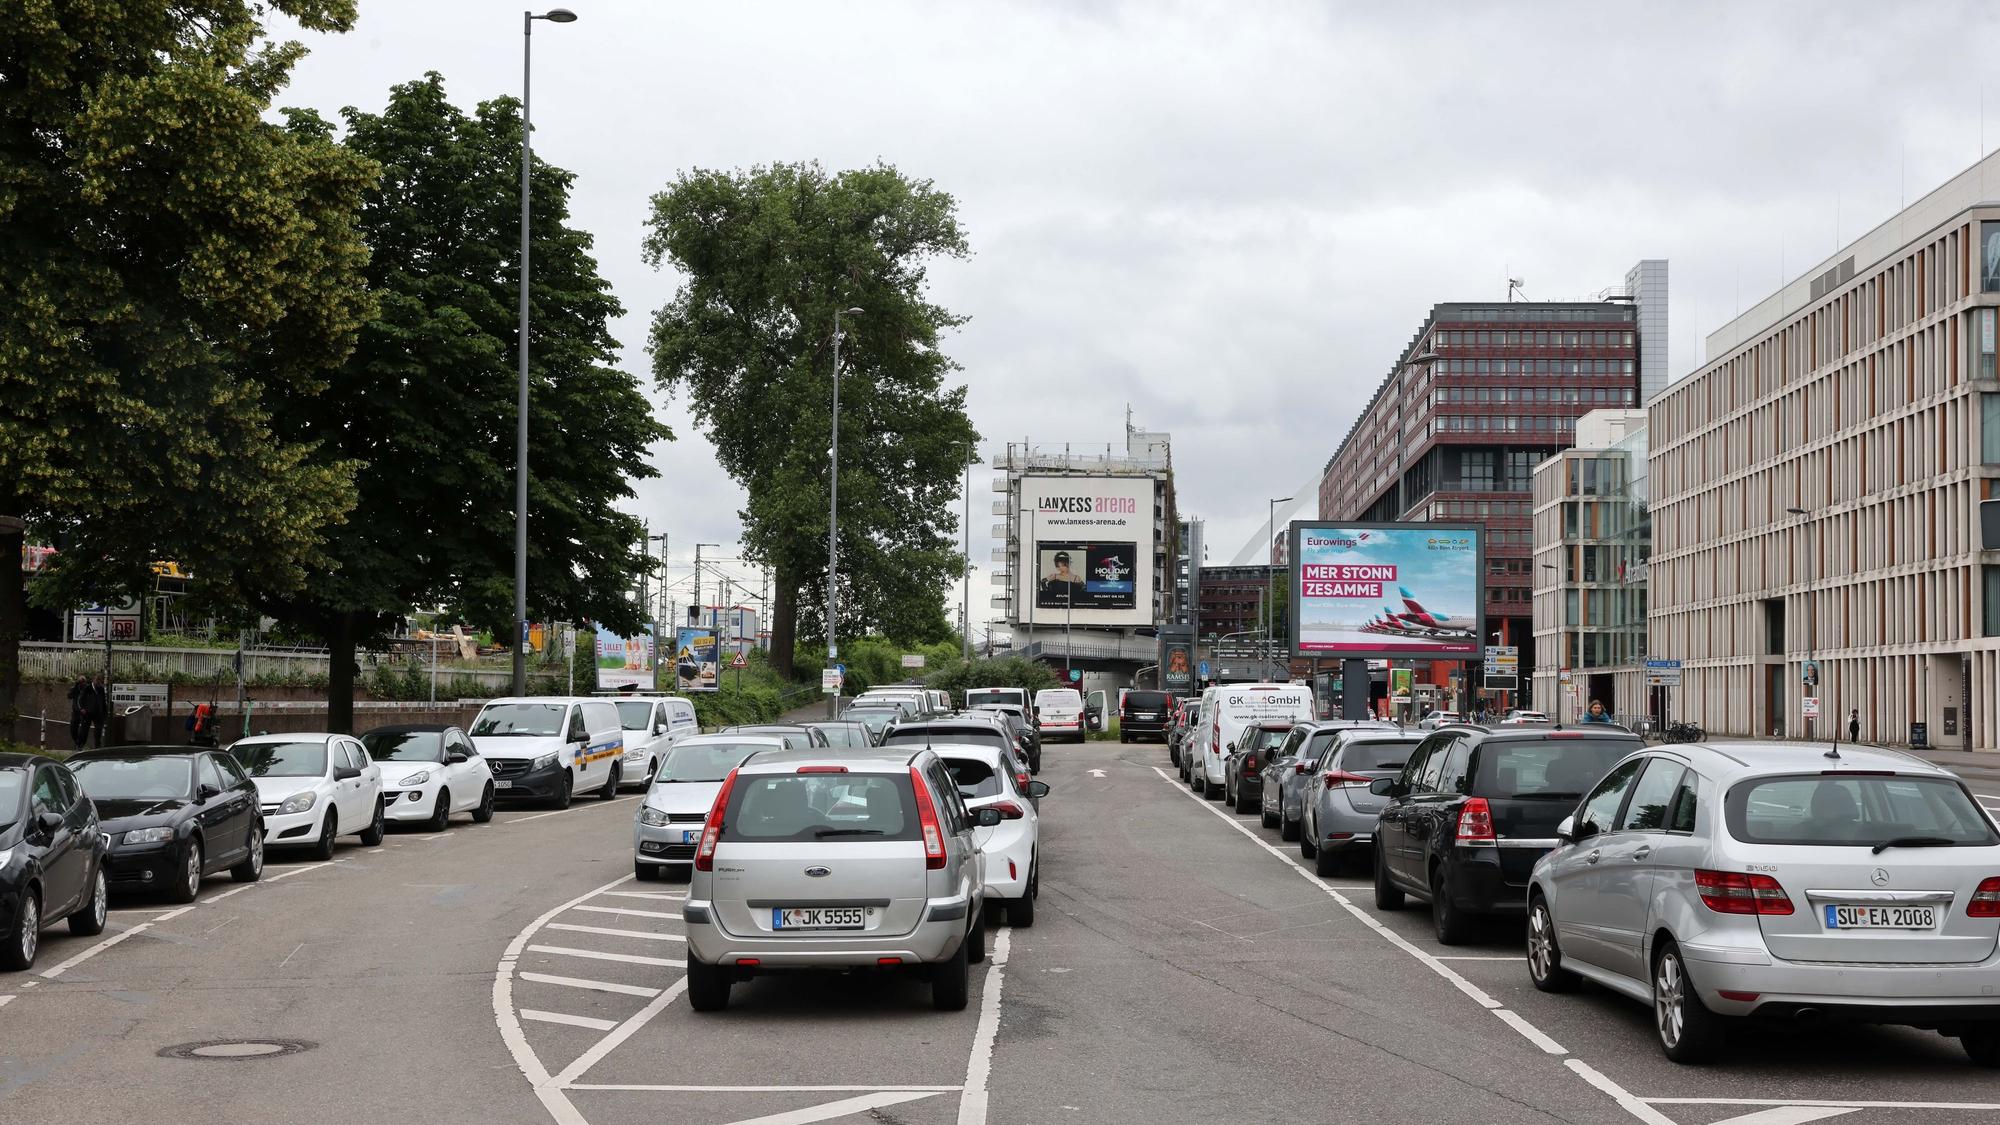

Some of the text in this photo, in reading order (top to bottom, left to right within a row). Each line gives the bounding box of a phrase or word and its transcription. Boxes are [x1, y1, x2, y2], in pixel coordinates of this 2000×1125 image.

[1039, 497, 1136, 513] LANXESS arena
[1048, 518, 1126, 526] www.lanxess-arena.de
[1307, 537, 1357, 549] Eurowings
[1307, 566, 1393, 579] MER STONN
[1306, 583, 1379, 596] ZESAMME
[115, 621, 133, 635] DB
[605, 643, 622, 651] LILLET
[1229, 696, 1301, 705] GK GmbH
[689, 833, 696, 841] K
[782, 909, 862, 925] K JK 5555
[1837, 909, 1933, 926] SU EA 2008
